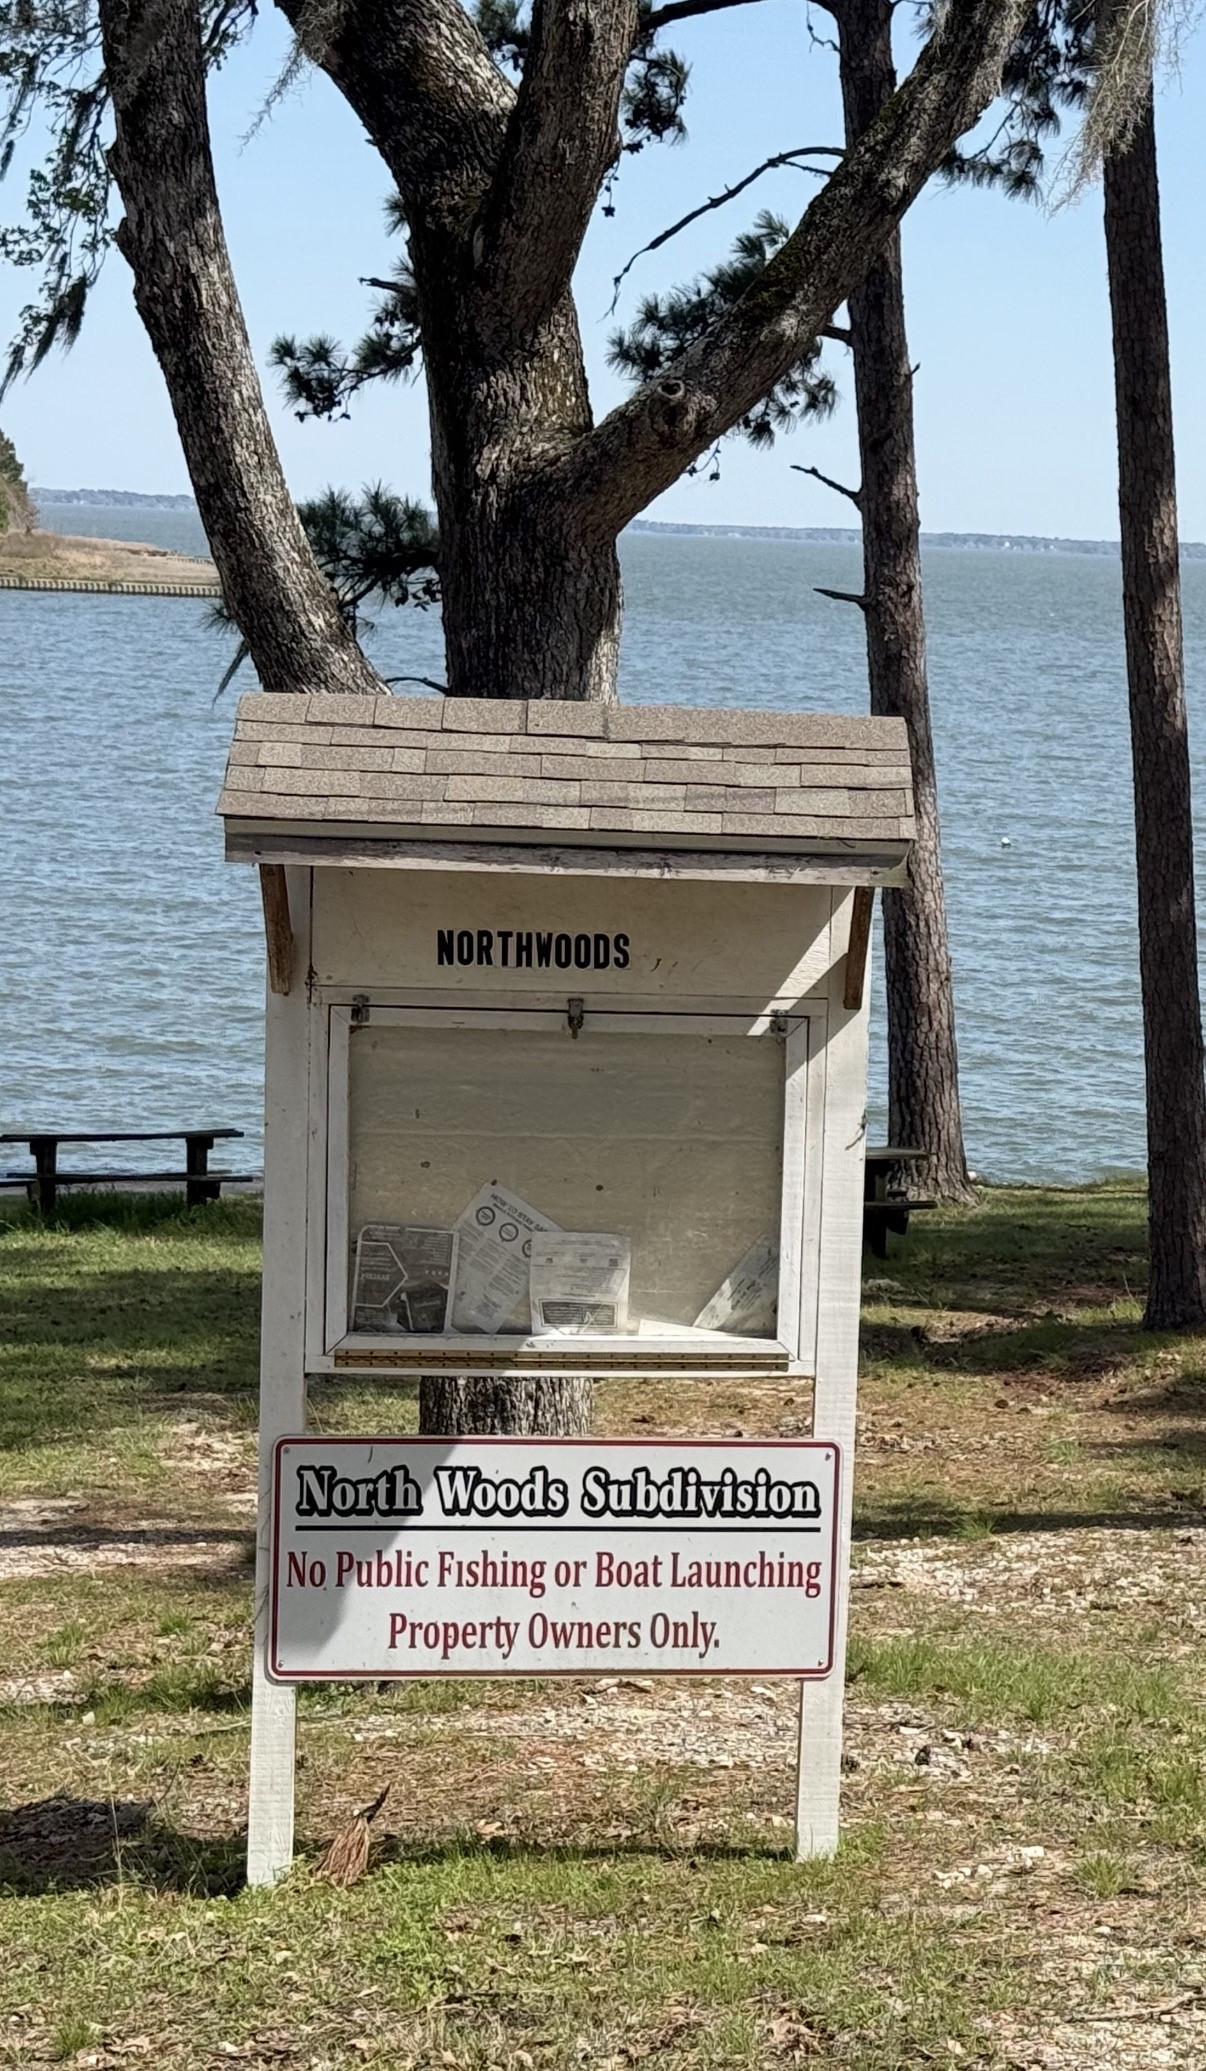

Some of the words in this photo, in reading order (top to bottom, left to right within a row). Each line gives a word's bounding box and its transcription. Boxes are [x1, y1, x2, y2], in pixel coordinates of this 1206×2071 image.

[437, 929, 630, 969] NORTHWOODS
[491, 1193, 509, 1208] HOW
[507, 1205, 518, 1215] TO
[517, 1212, 535, 1225] STAY
[296, 1464, 423, 1517] North
[434, 1465, 569, 1518] Woods
[581, 1466, 822, 1520] Subdivision
[287, 1551, 326, 1588] No
[335, 1550, 429, 1588] Public
[437, 1550, 547, 1598] Fishing
[554, 1558, 587, 1588] or
[595, 1551, 663, 1589] Boat
[669, 1551, 823, 1599] Launching
[387, 1611, 520, 1659] Property
[527, 1611, 641, 1649] Owners
[649, 1611, 721, 1659] Only.
